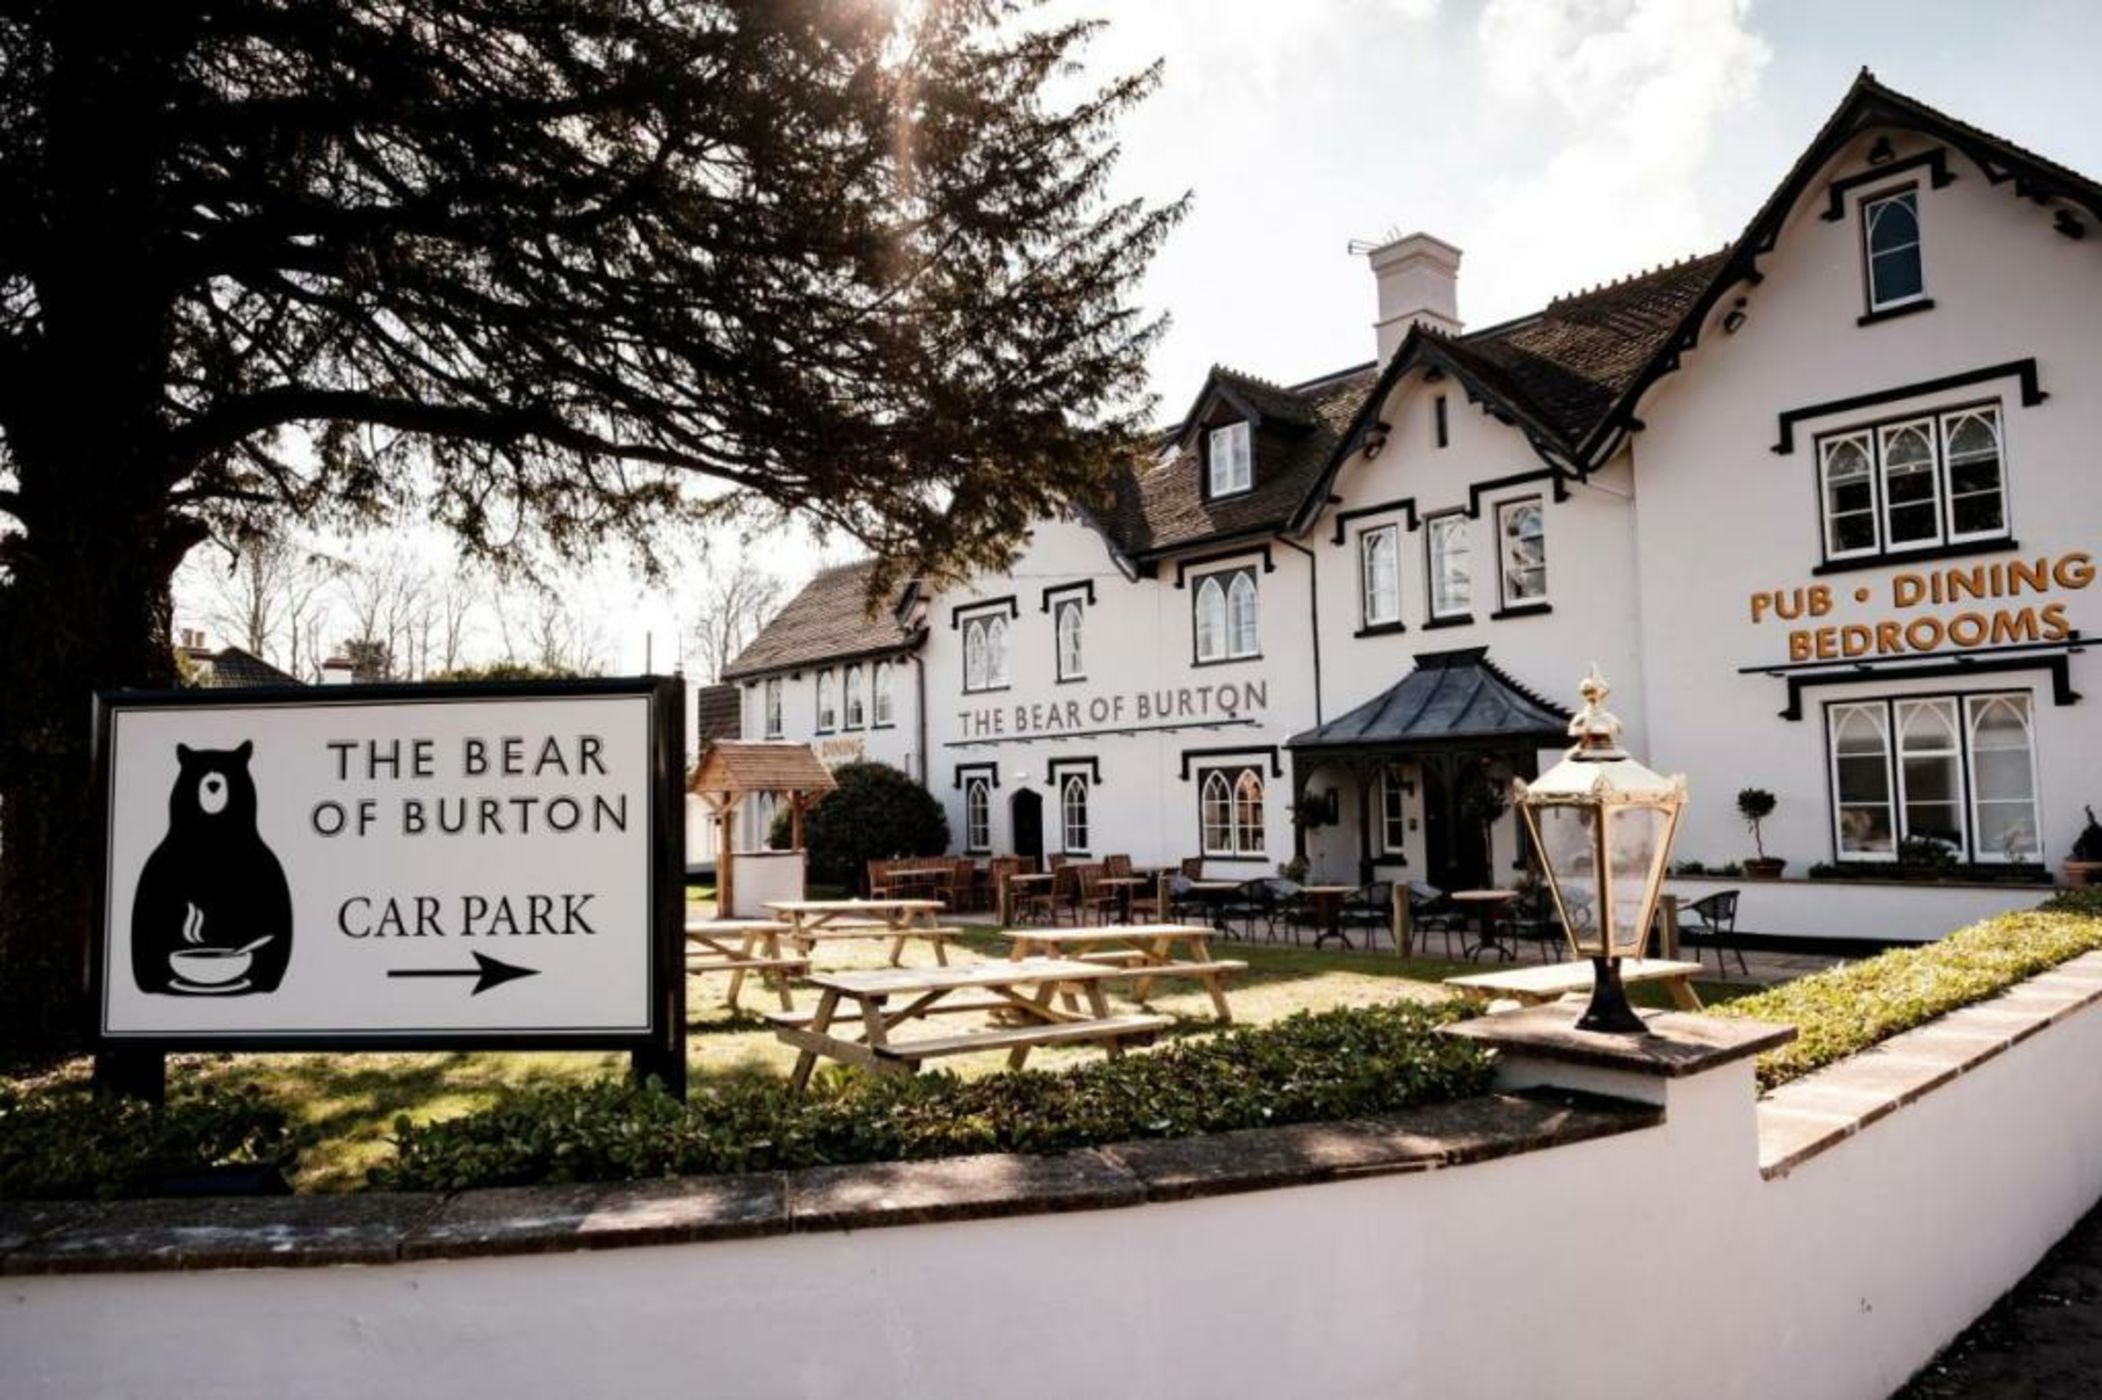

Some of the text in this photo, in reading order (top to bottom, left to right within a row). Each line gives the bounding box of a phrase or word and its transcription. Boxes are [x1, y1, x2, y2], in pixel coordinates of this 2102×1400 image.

[1750, 552, 2097, 624] PUB DINING
[1788, 603, 2071, 661] BEDROOMS
[958, 679, 1268, 737] THE BEAR OF BURTON
[327, 735, 608, 781] THE BEAR
[312, 794, 627, 837] OF BURTON
[338, 893, 597, 939] CAR PARK
